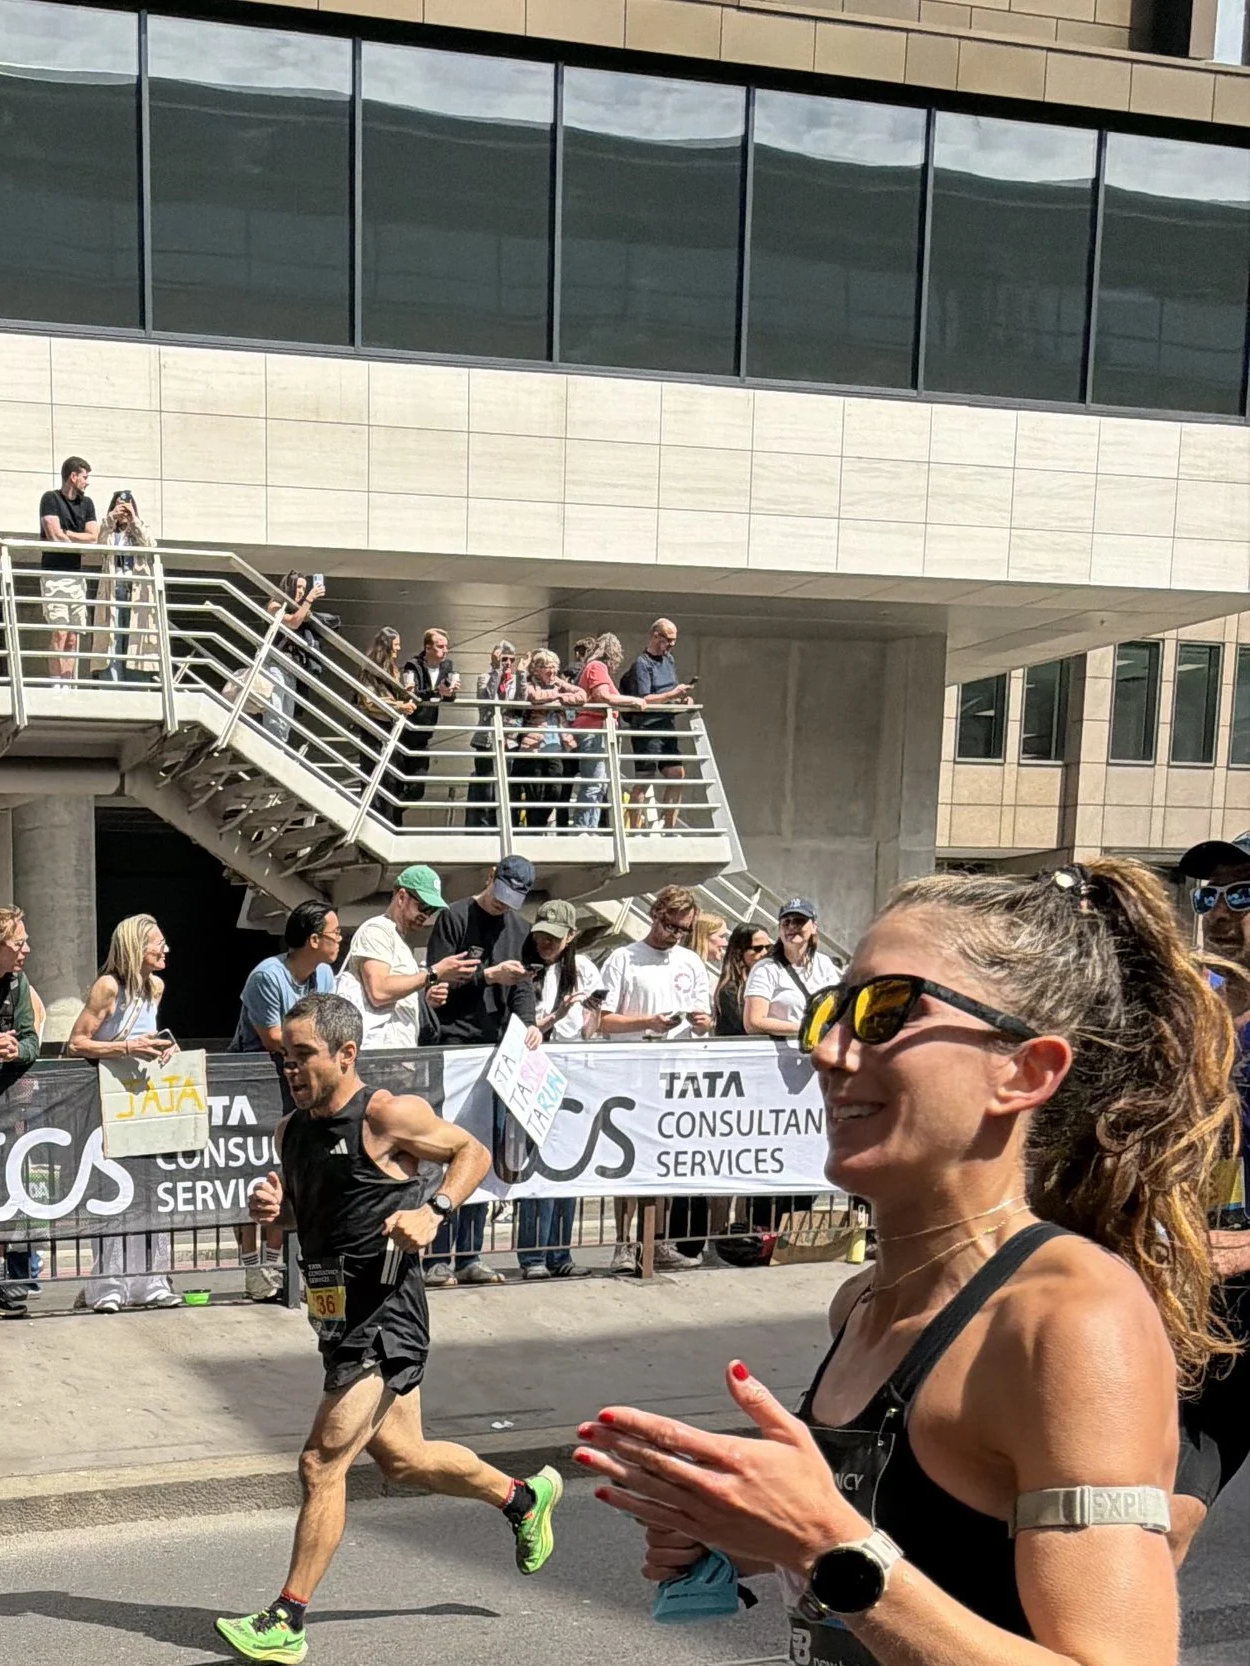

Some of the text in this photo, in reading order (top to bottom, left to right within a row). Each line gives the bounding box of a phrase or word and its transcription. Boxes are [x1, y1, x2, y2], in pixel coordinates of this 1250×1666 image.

[659, 1070, 745, 1099] TATA
[207, 1095, 257, 1126] TA
[657, 1107, 823, 1139] CONSULTAN
[656, 1147, 784, 1179] SERVICES
[156, 1176, 267, 1213] SERVI
